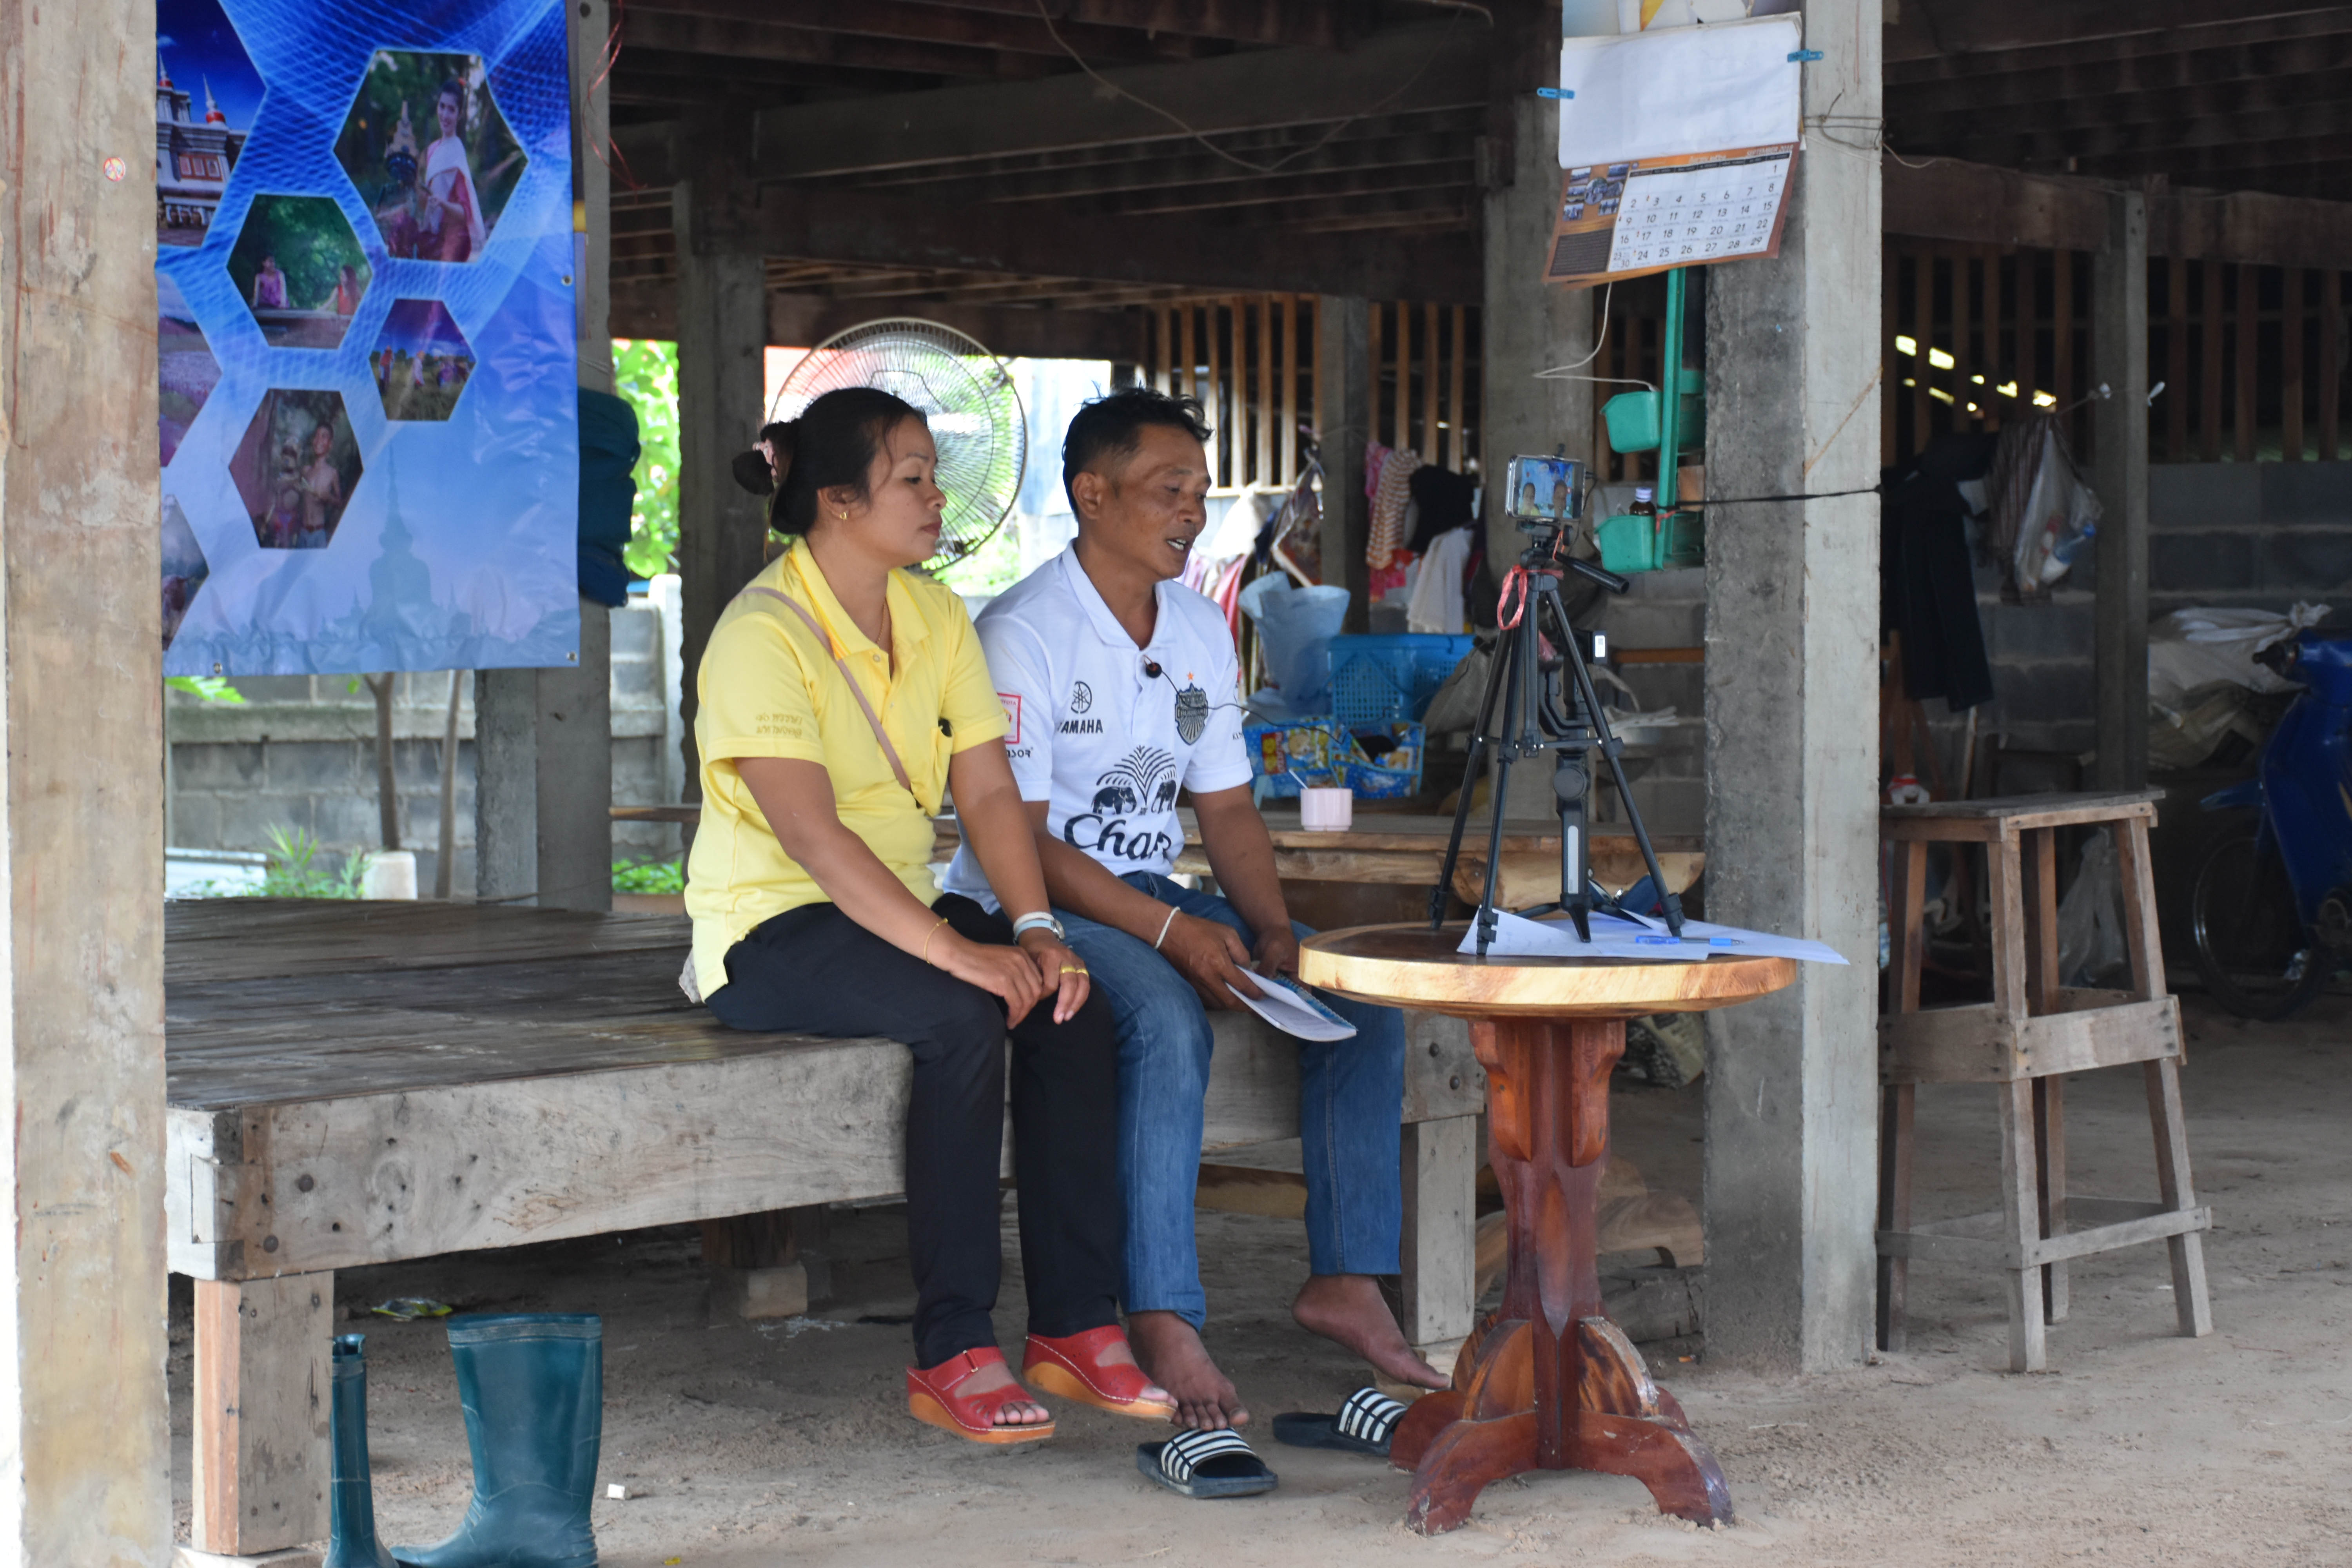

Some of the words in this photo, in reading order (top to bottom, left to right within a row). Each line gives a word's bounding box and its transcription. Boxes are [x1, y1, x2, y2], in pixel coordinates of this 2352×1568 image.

[1774, 165, 1777, 173] 1
[1631, 199, 1636, 208] 2
[1653, 198, 1659, 206] 3
[1700, 193, 1706, 202] 5
[1724, 191, 1730, 200] 6
[1747, 187, 1753, 196] 7
[1768, 183, 1774, 192] 8
[1647, 214, 1656, 223] 10
[1693, 210, 1702, 218] 12
[1718, 209, 1727, 217] 13
[1741, 205, 1749, 214] 14
[1764, 201, 1772, 210] 15
[1621, 235, 1629, 244] 16
[1642, 232, 1651, 241] 17
[1664, 229, 1673, 238] 18
[1710, 226, 1723, 235] 20
[1735, 223, 1746, 232] 21
[1757, 219, 1768, 229] 22
[1613, 252, 1622, 260] 23
[1638, 251, 1648, 260] 24
[1659, 247, 1670, 257] 25
[1681, 245, 1692, 254] 26
[1705, 243, 1717, 252] 27
[1728, 240, 1740, 249] 28
[1750, 236, 1762, 246] 29
